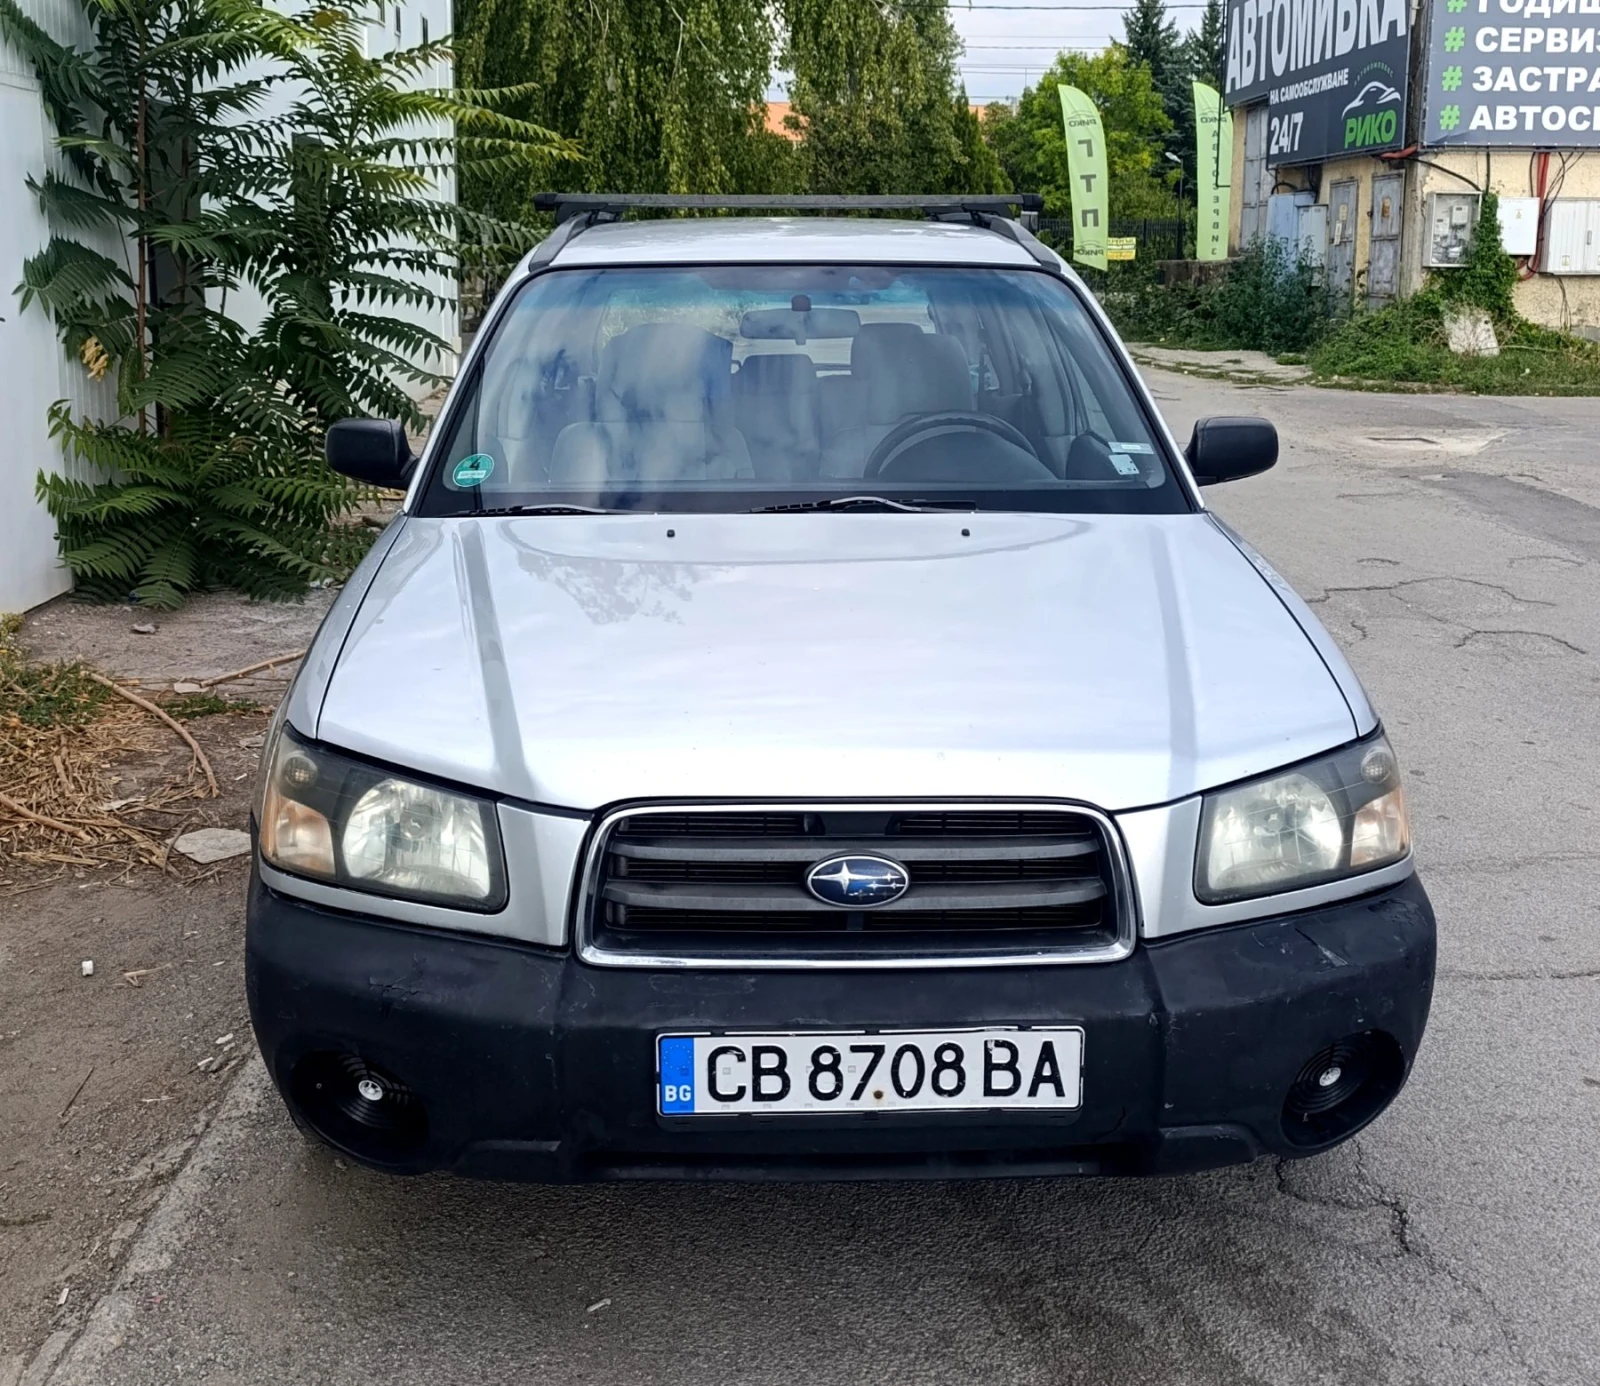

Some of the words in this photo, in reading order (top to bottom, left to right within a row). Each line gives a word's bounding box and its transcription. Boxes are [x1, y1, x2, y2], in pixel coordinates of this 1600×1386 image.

[1478, 0, 1600, 19] ОДИ
[1475, 26, 1600, 53] СЕРВИ
[1269, 88, 1280, 105] НА
[1280, 68, 1349, 102] САМООБСЛУЖВАНЕ
[1269, 112, 1303, 155] 24/7
[1344, 109, 1397, 149] РИКО
[469, 456, 482, 471] 4
[706, 1044, 791, 1102] CB
[808, 1043, 966, 1101] 8708
[983, 1039, 1066, 1098] BA
[664, 1084, 692, 1102] BG
